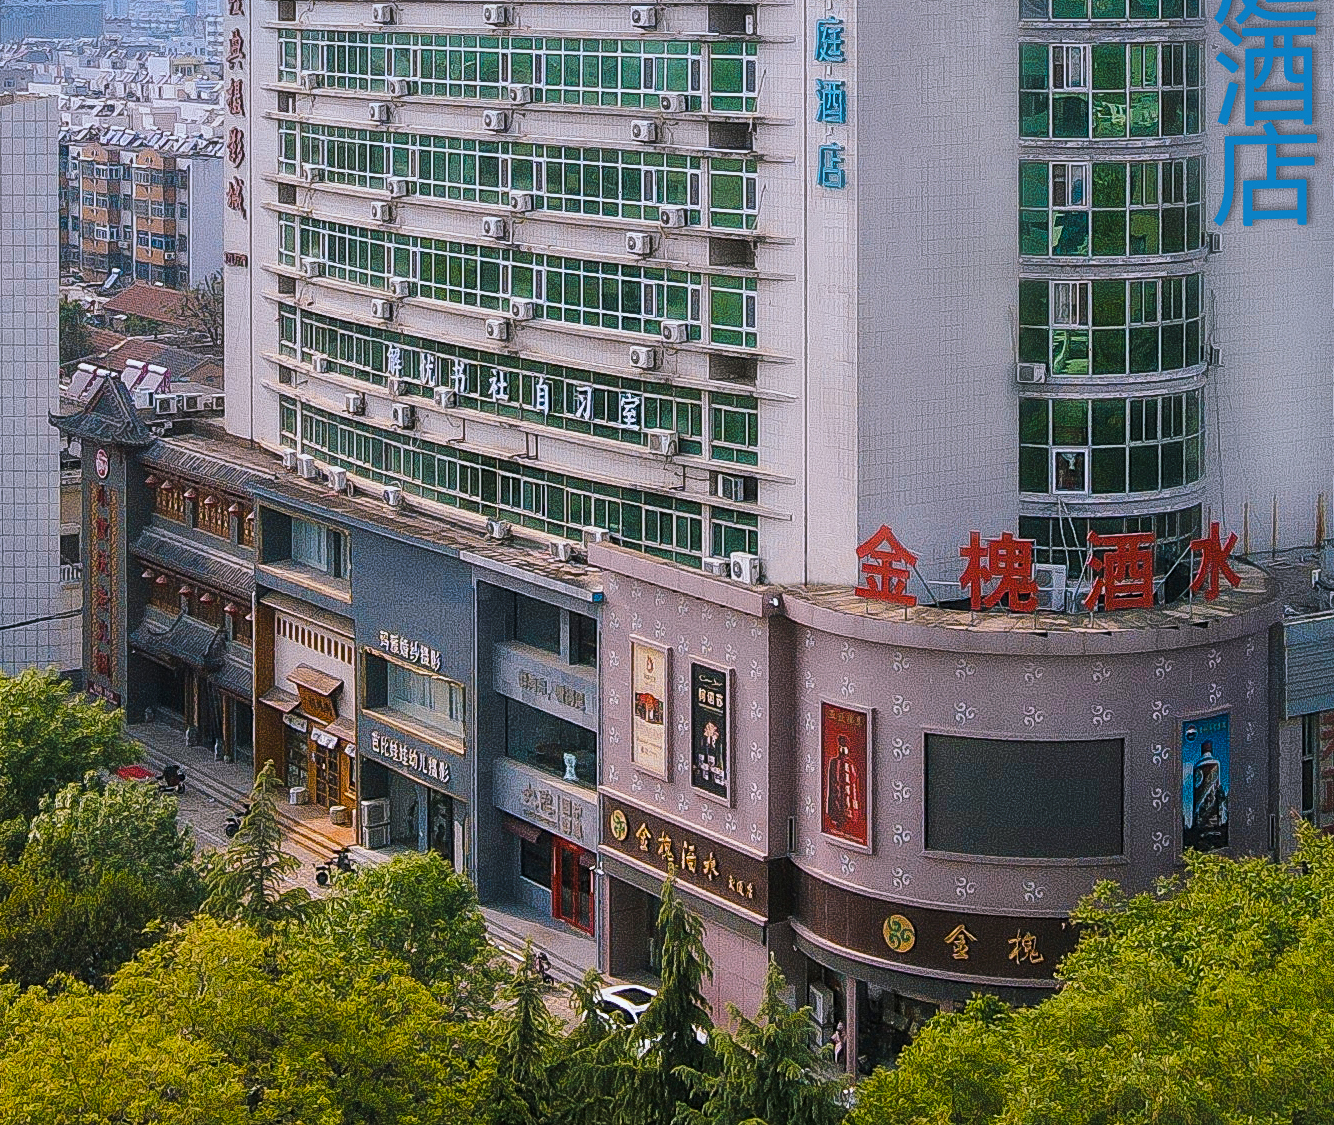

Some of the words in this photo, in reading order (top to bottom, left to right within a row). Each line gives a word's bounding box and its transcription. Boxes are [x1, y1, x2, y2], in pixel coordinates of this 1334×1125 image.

[387, 343, 641, 431] 解忧书社自习室
[855, 521, 1241, 613] 金槐酒水
